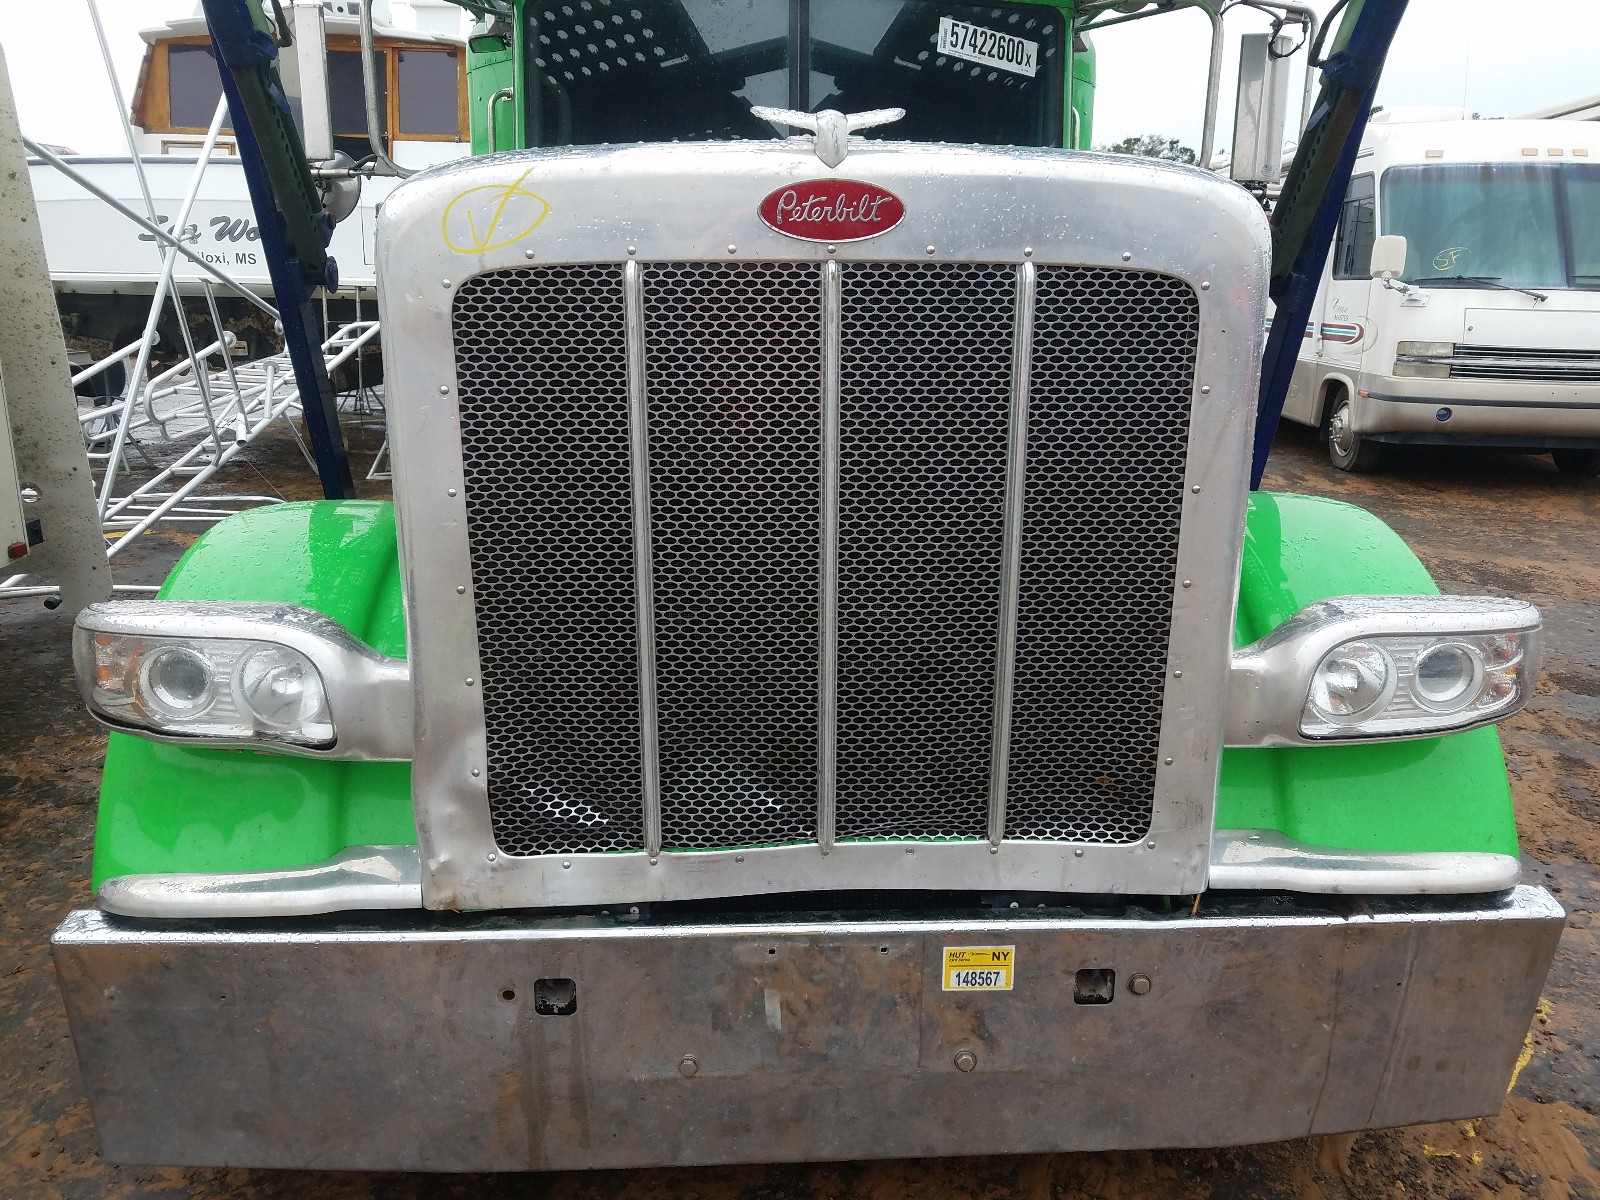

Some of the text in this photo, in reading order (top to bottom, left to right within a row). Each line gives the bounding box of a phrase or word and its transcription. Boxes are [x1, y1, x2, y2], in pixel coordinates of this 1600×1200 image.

[777, 190, 892, 224] Peterbilt
[188, 251, 257, 265] loxi, MS
[1436, 249, 1462, 267] SF
[949, 951, 1011, 962] HUT NY
[955, 971, 1001, 987] 148567
